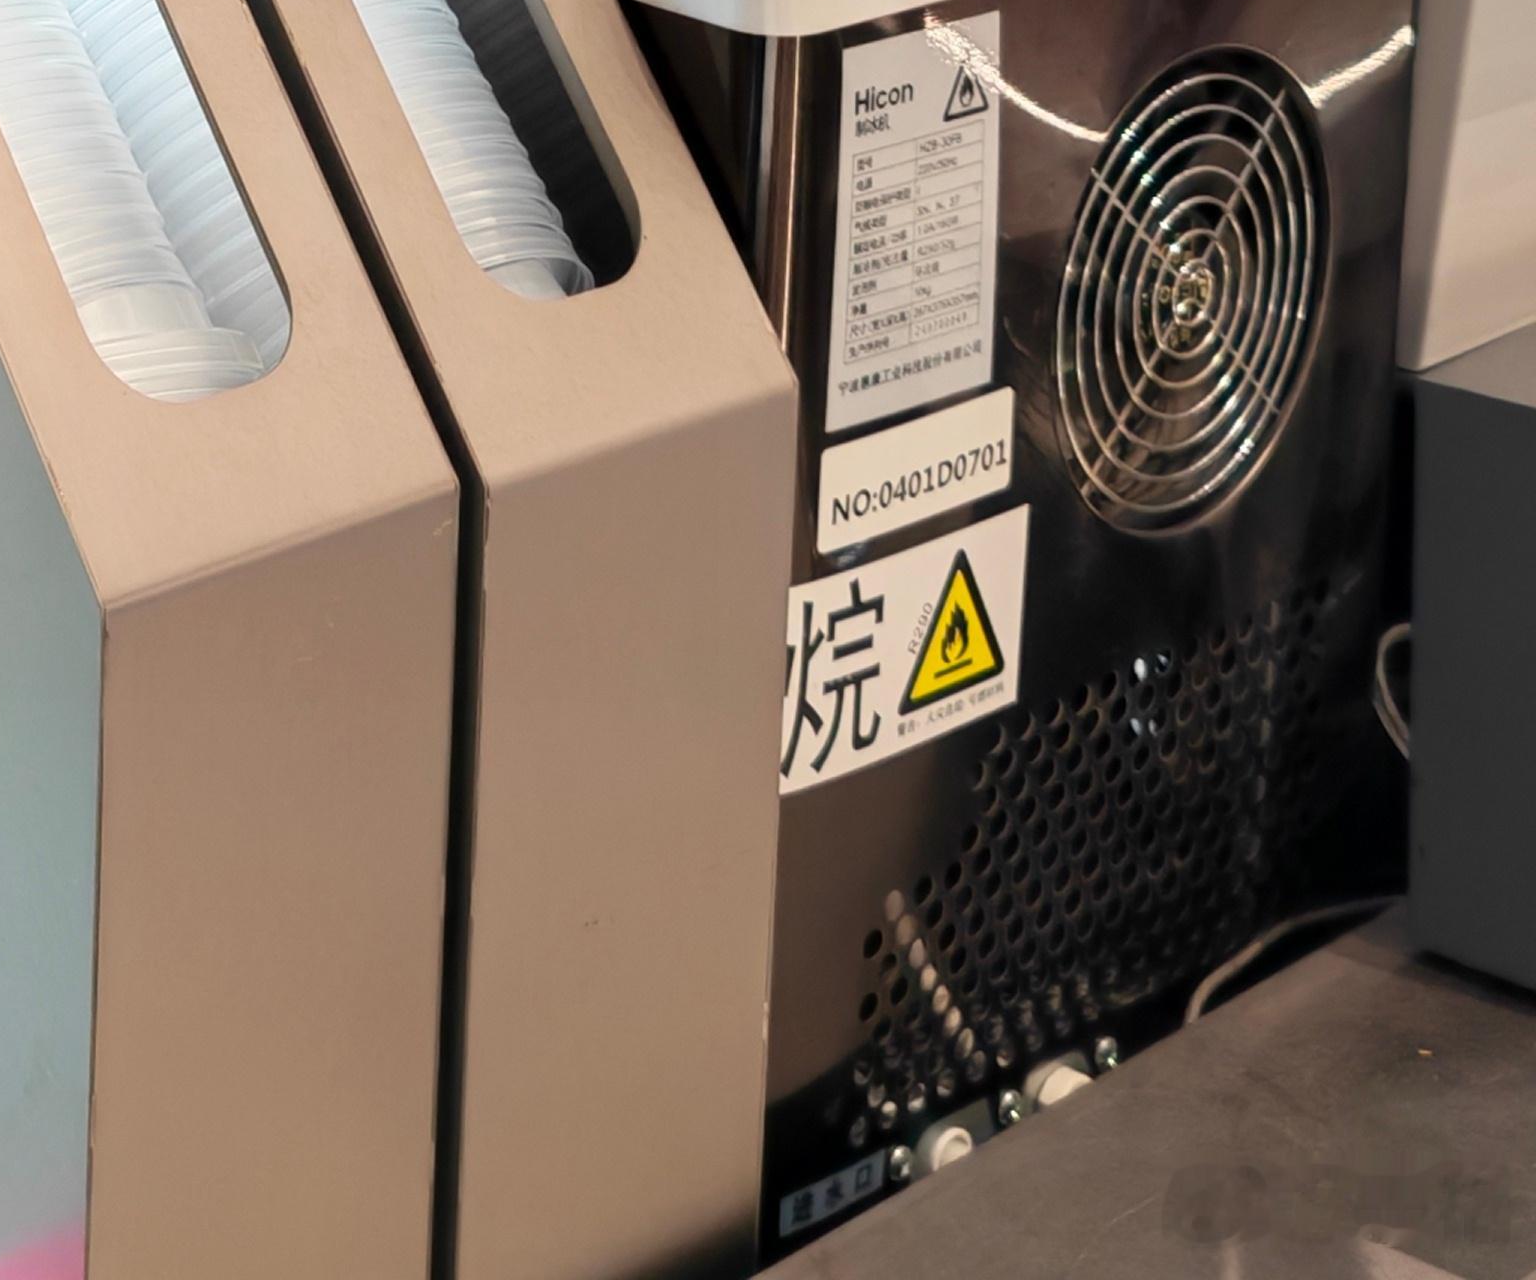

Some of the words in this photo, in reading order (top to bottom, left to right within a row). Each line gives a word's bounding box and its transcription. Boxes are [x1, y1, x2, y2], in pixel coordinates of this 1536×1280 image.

[854, 83, 914, 116] Hicon
[831, 438, 1008, 525] NO:0401D0701
[907, 601, 934, 655] R290
[780, 577, 885, 778] 烷
